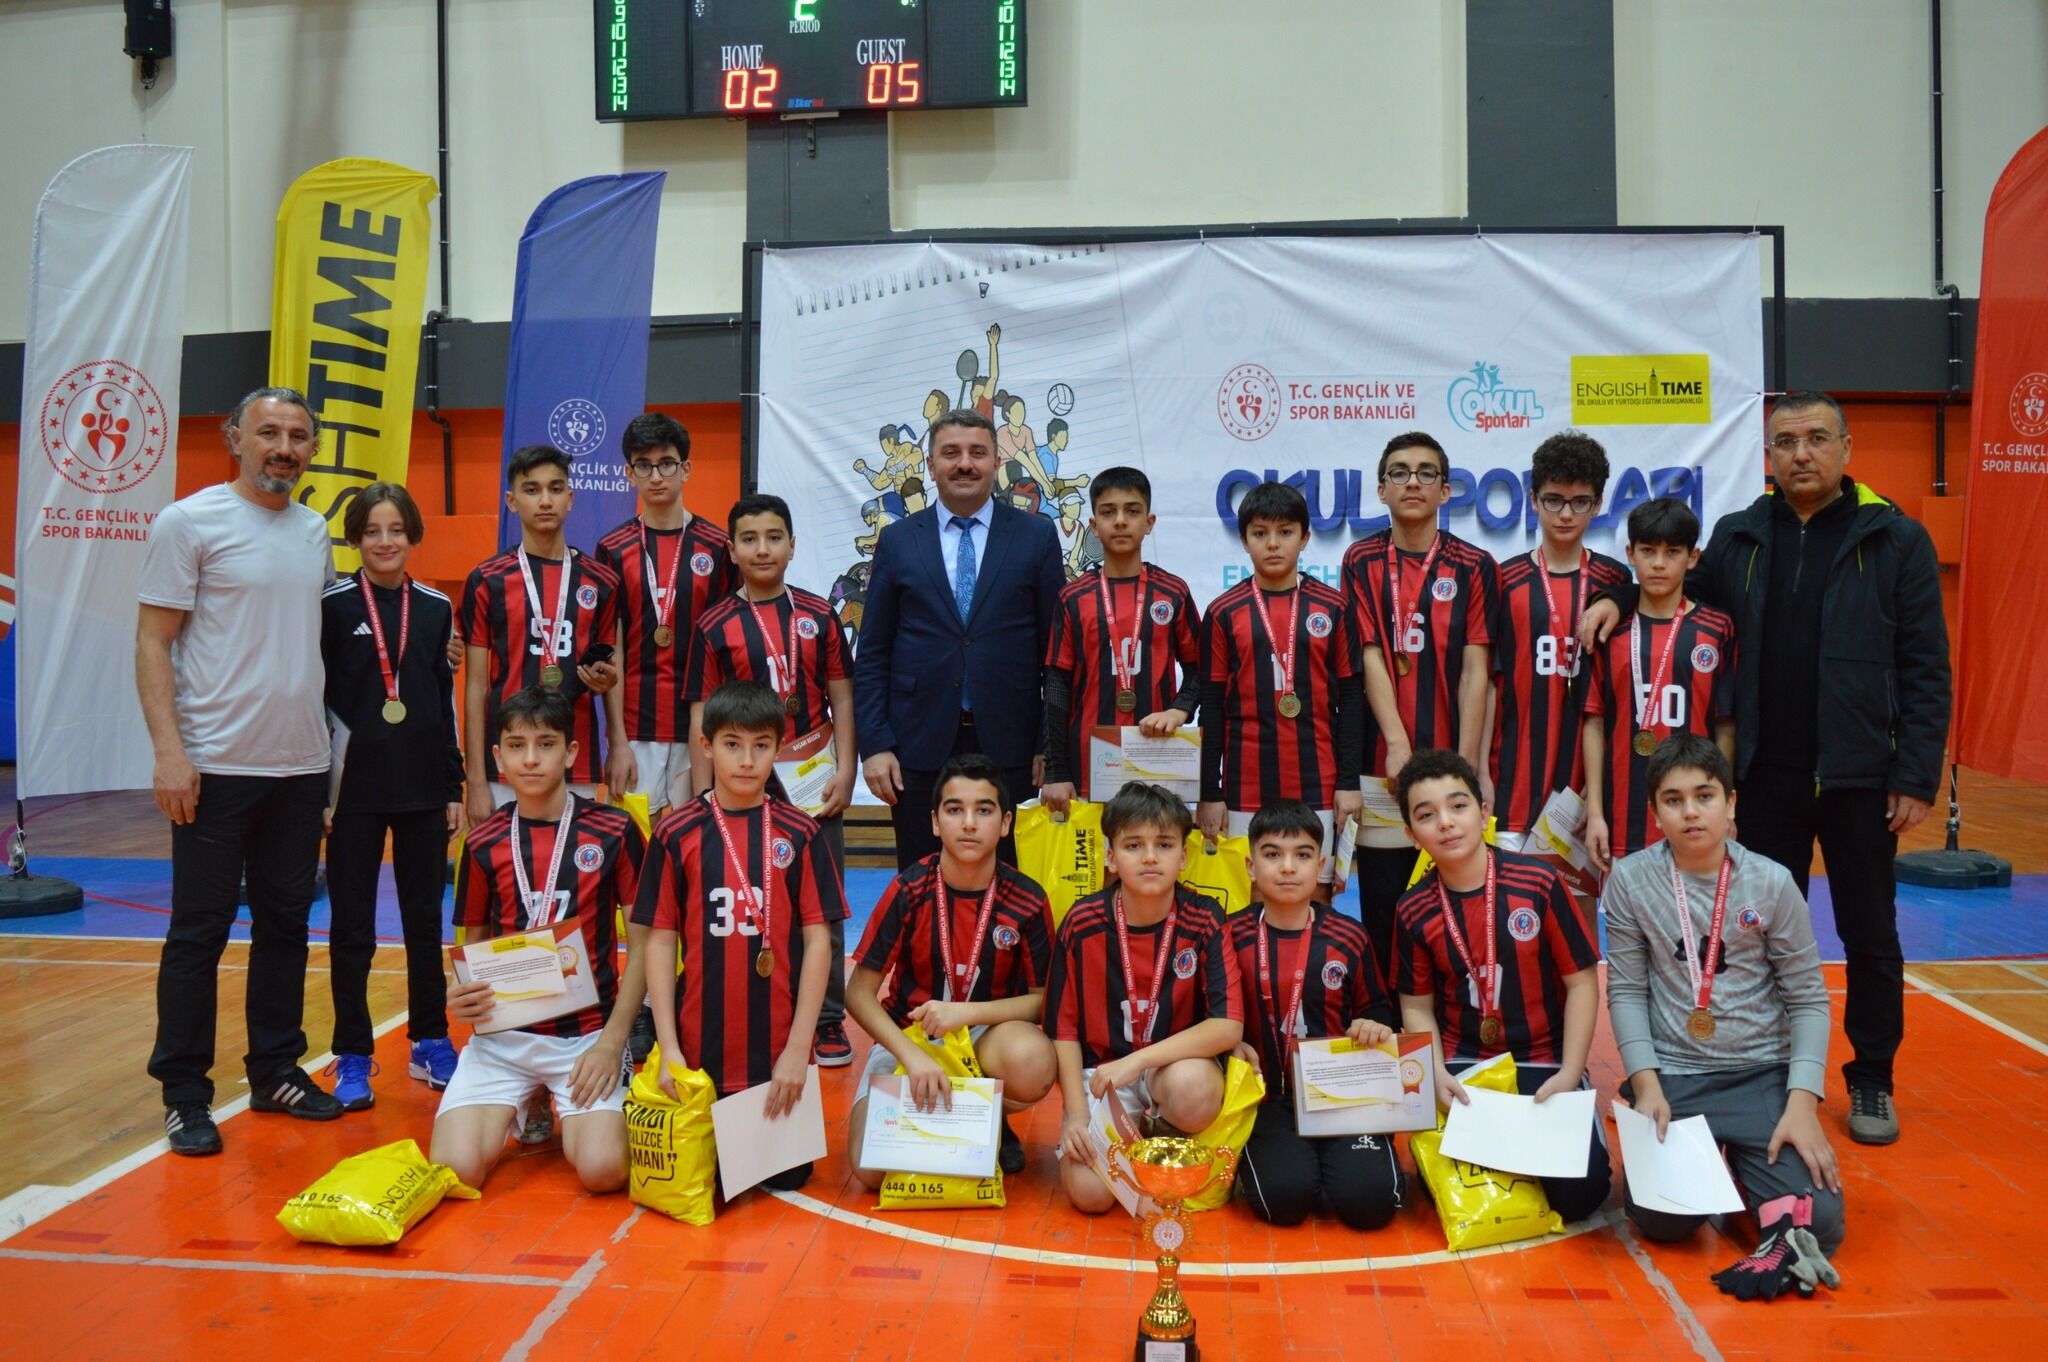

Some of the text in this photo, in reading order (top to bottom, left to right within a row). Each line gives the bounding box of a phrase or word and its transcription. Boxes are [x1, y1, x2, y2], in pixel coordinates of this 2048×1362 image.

[999, 5, 1014, 23] 10
[611, 23, 626, 40] 10
[789, 19, 821, 34] PERIOD
[999, 24, 1015, 41] 11
[612, 41, 627, 58] 11
[721, 44, 764, 71] HOME
[856, 38, 906, 65] GUEST
[999, 42, 1015, 60] 12
[612, 58, 627, 76] 12
[1000, 60, 1015, 78] 13
[612, 76, 627, 94] 13
[725, 69, 776, 109] 02
[867, 63, 919, 104] 05
[1000, 79, 1015, 96] 14
[613, 94, 628, 112] 14
[1288, 381, 1415, 402] T.C. GENÇLİK VE
[1576, 381, 1703, 397] ENGLISH TIME
[1290, 402, 1415, 420] SPOR BAKANLIĞI
[1475, 411, 1530, 432] Sporları
[1983, 443, 2003, 456] T.C.
[568, 462, 608, 478] NÇLİK
[1982, 459, 2011, 473] SPOR
[568, 478, 630, 492] AKANLIĞI
[43, 507, 71, 521] T.C.
[75, 508, 138, 524] GENÇLİK
[42, 525, 147, 542] SPOR BAKANLI
[1075, 828, 1089, 871] TIME
[709, 886, 764, 937] 33
[885, 1182, 944, 1194] 444 0 165
